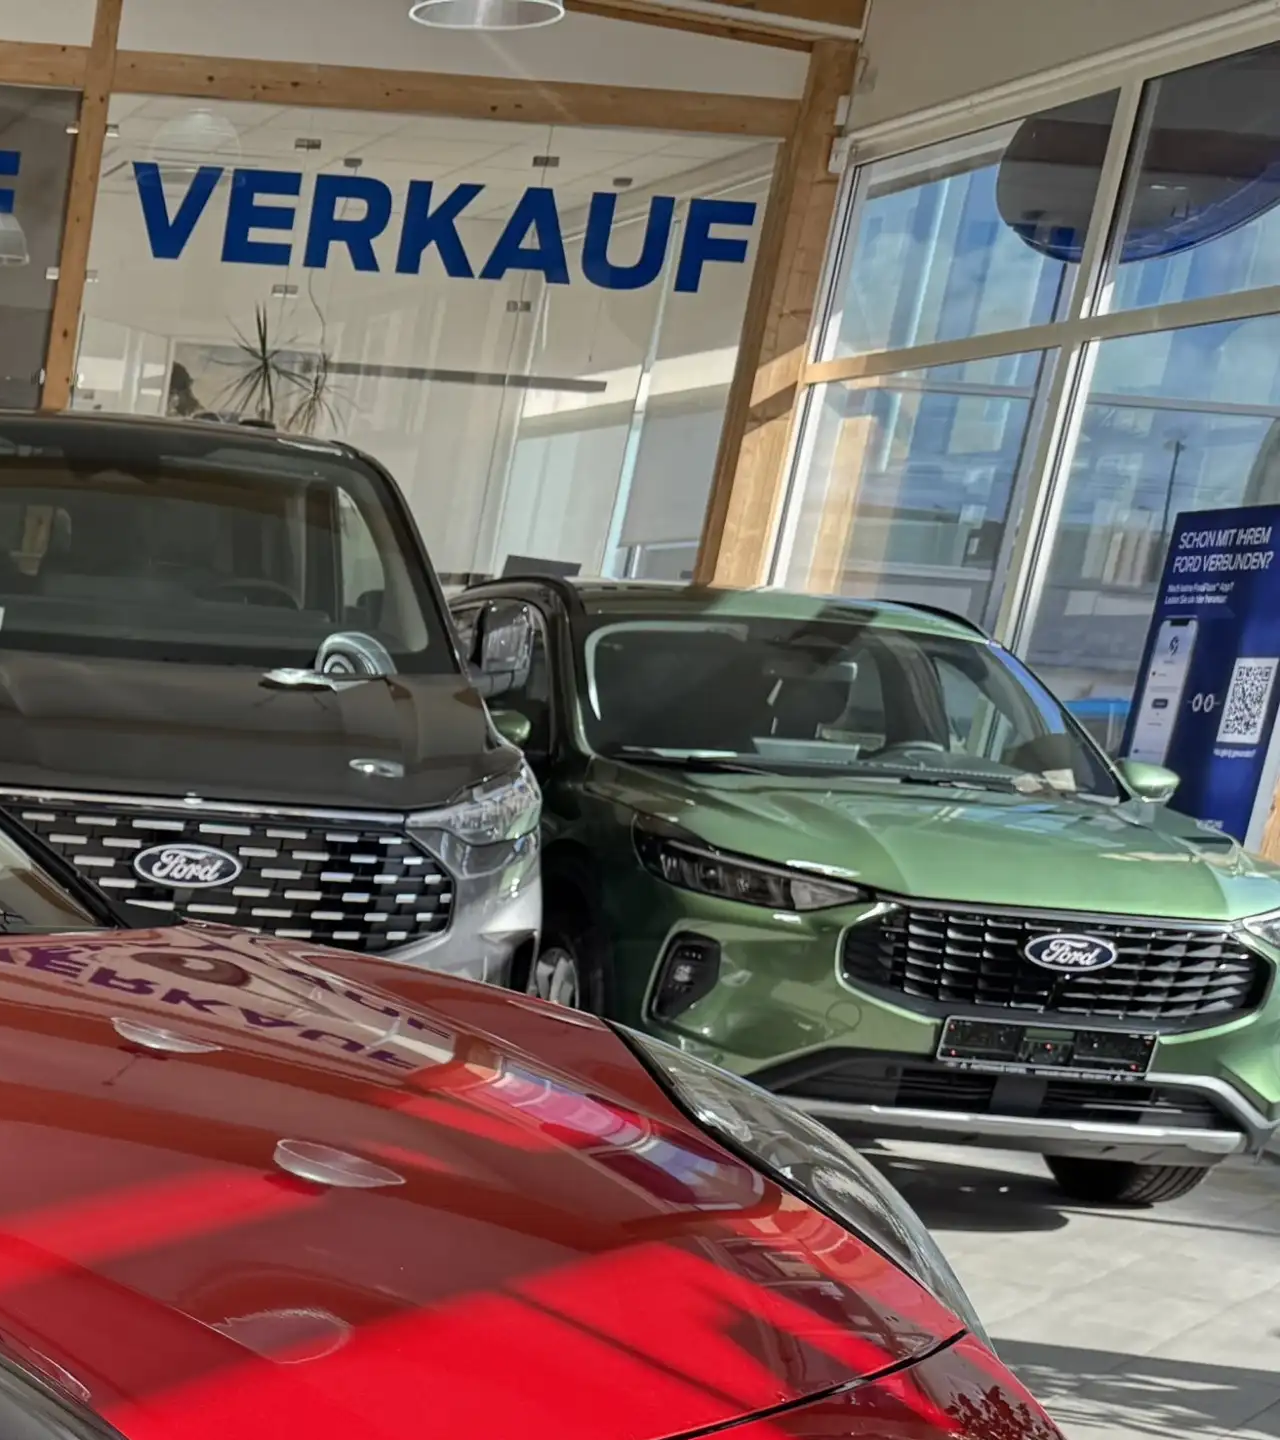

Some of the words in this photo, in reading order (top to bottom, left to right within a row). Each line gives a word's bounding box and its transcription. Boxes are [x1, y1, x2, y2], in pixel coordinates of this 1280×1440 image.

[132, 161, 758, 293] VERKAUF
[1178, 530, 1217, 549] SCHON
[1215, 528, 1238, 547] MIT
[1236, 525, 1273, 546] IHREM
[1173, 555, 1202, 574] FORD
[1203, 550, 1275, 572] VERBUNDEN?
[151, 848, 224, 882] Ford
[1040, 939, 1102, 966] Ford
